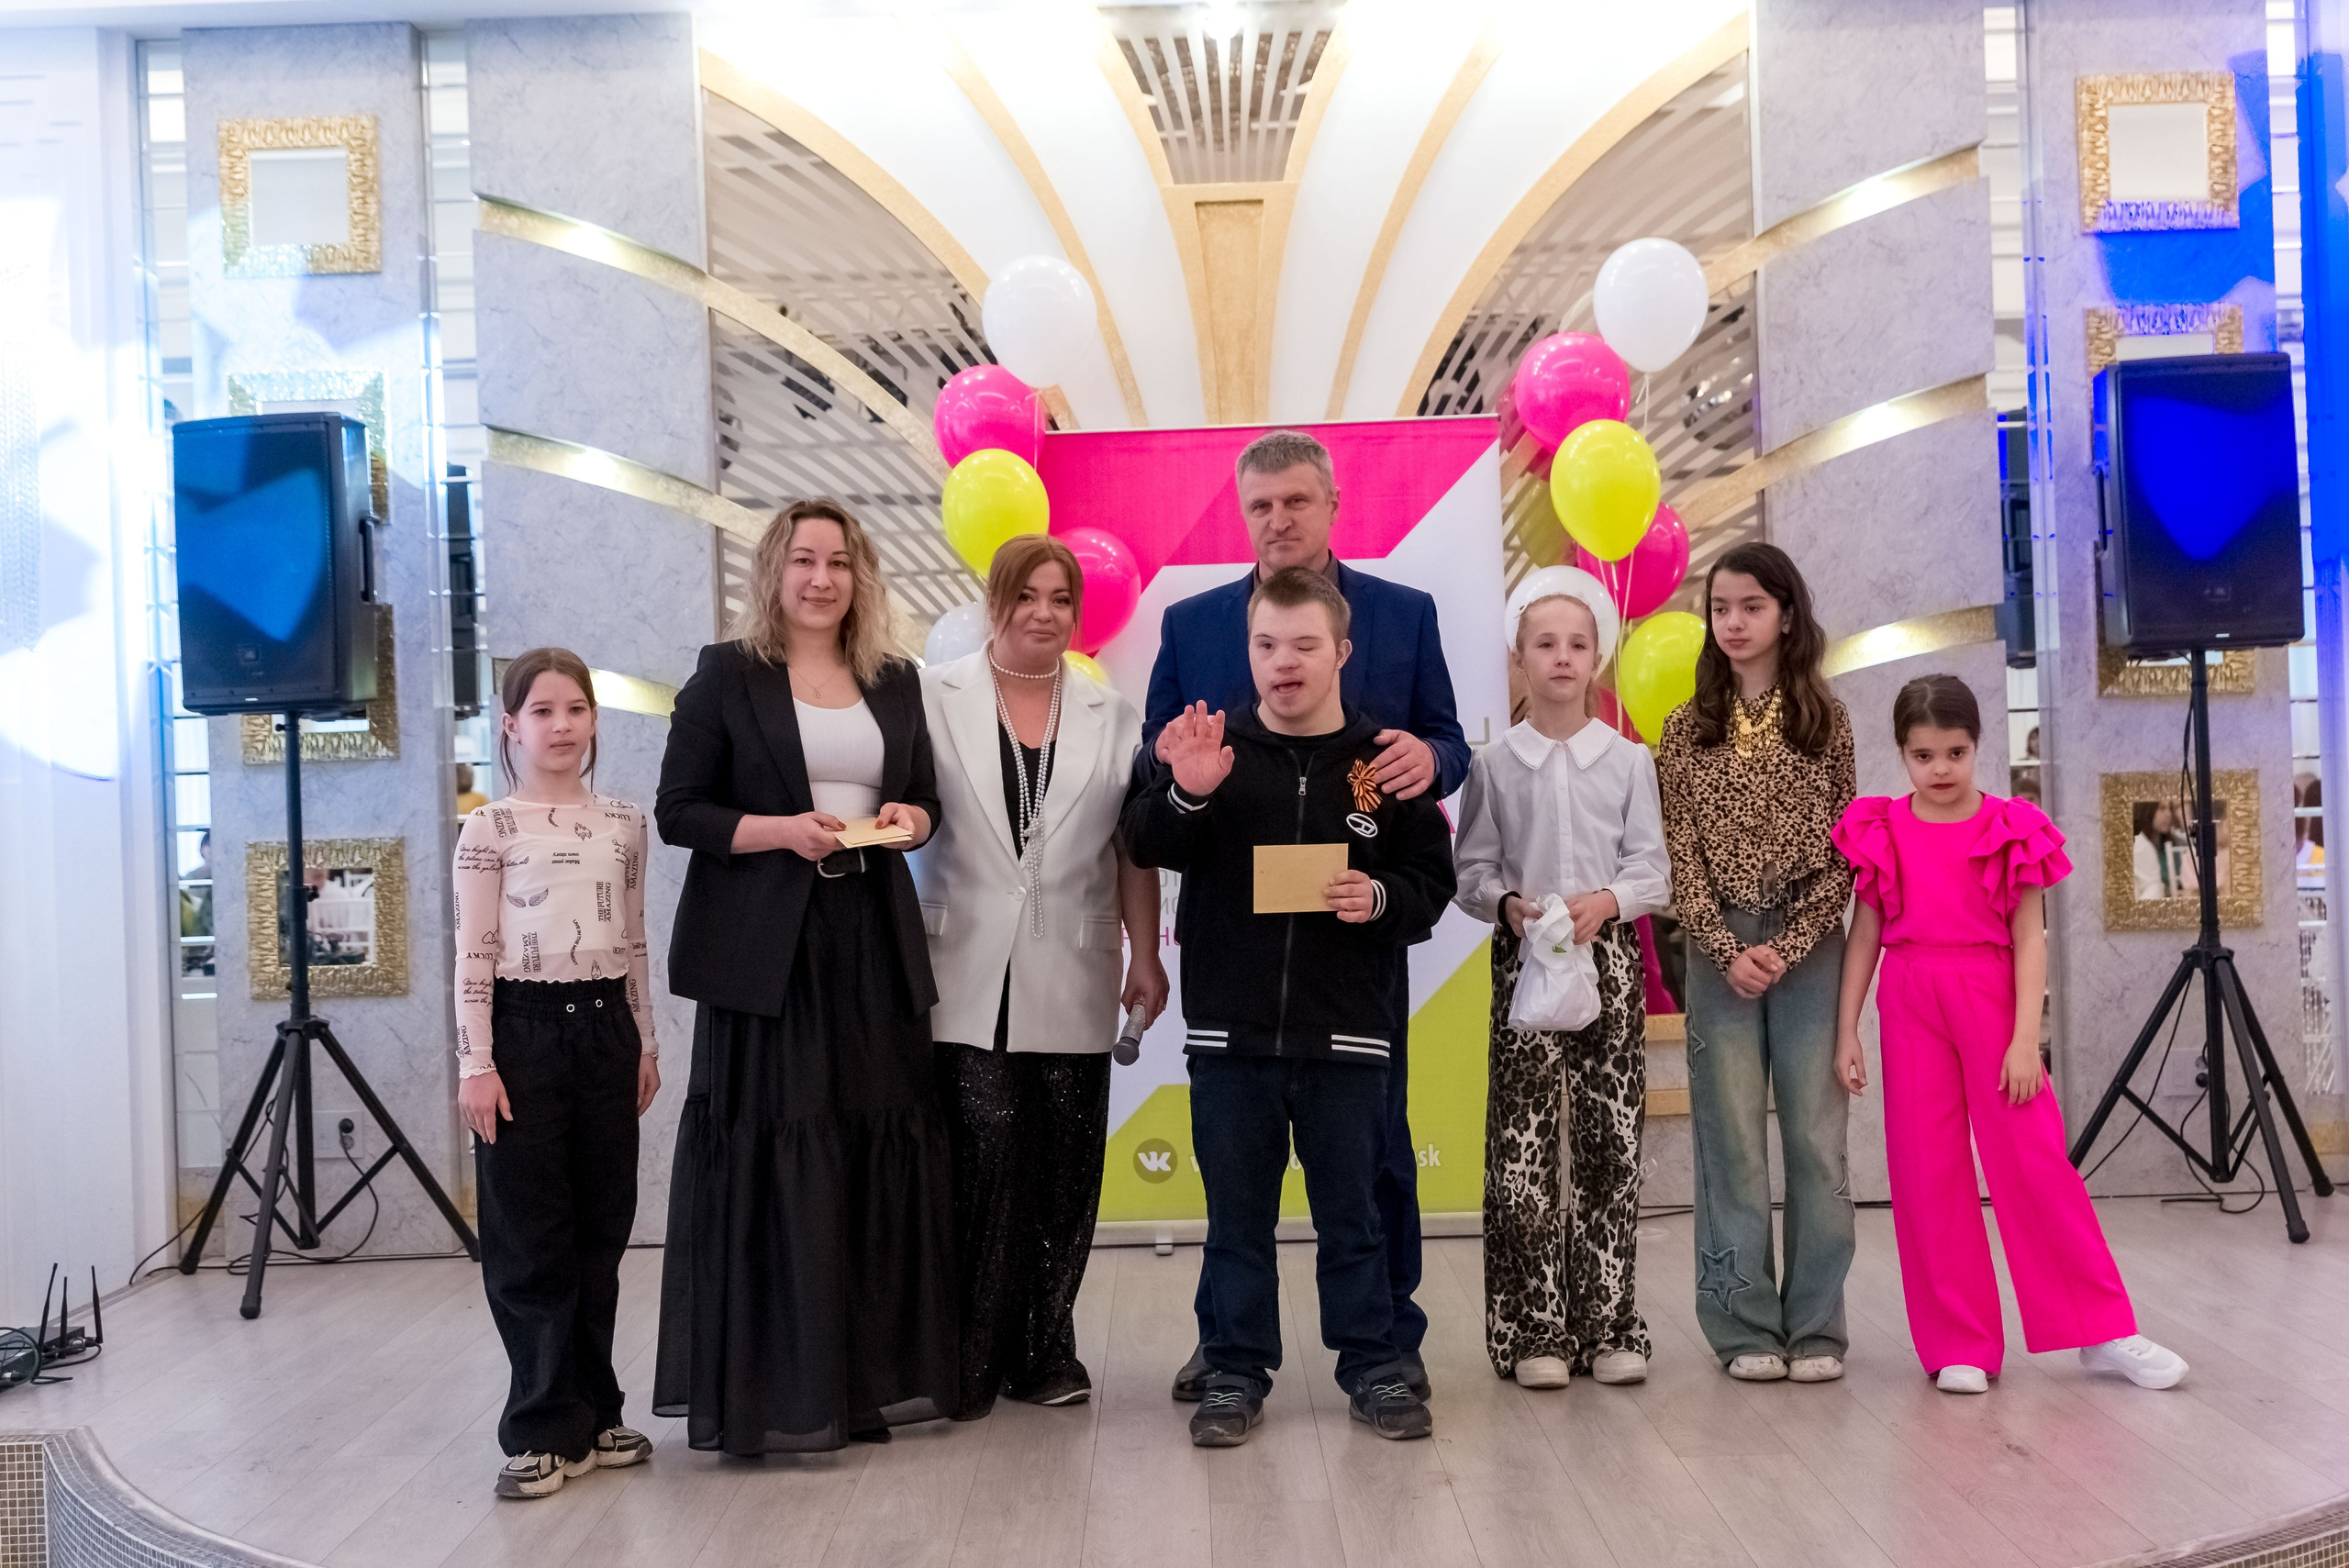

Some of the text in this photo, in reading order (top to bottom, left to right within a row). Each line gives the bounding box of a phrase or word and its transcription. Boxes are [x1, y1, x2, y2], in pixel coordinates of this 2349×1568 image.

[604, 812, 630, 821] LUCKY
[629, 851, 640, 890] AMAZING
[596, 881, 605, 907] FUTURE
[573, 919, 581, 929] LIVE
[521, 933, 531, 973] AMAZING
[573, 935, 582, 946] THE
[530, 946, 542, 973] FUTURE
[570, 944, 579, 966] MOMENT
[629, 978, 640, 1013] AMAZING
